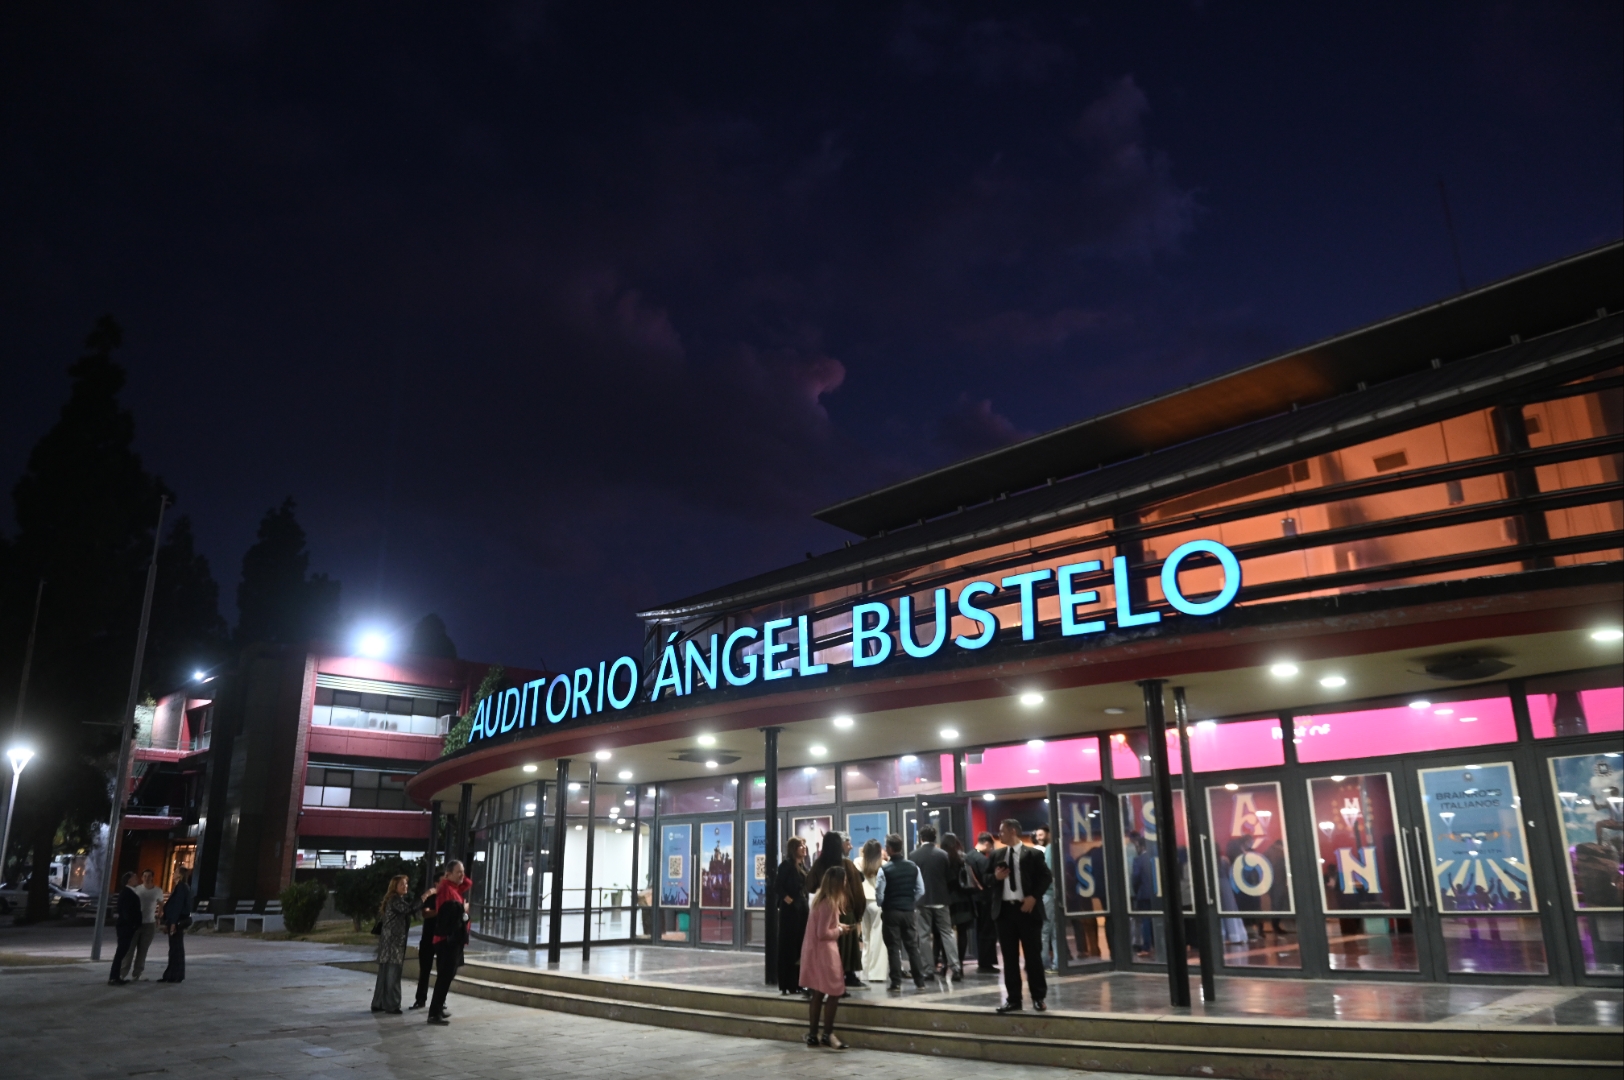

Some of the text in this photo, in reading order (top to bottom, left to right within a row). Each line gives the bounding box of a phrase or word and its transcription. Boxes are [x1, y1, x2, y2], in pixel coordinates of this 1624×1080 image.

[467, 540, 1241, 743] AUDITORIO ÁNGEL BUSTELO
[1231, 793, 1265, 837] A
[1441, 799, 1500, 810] ITALIANOS
[1334, 846, 1383, 894] N
